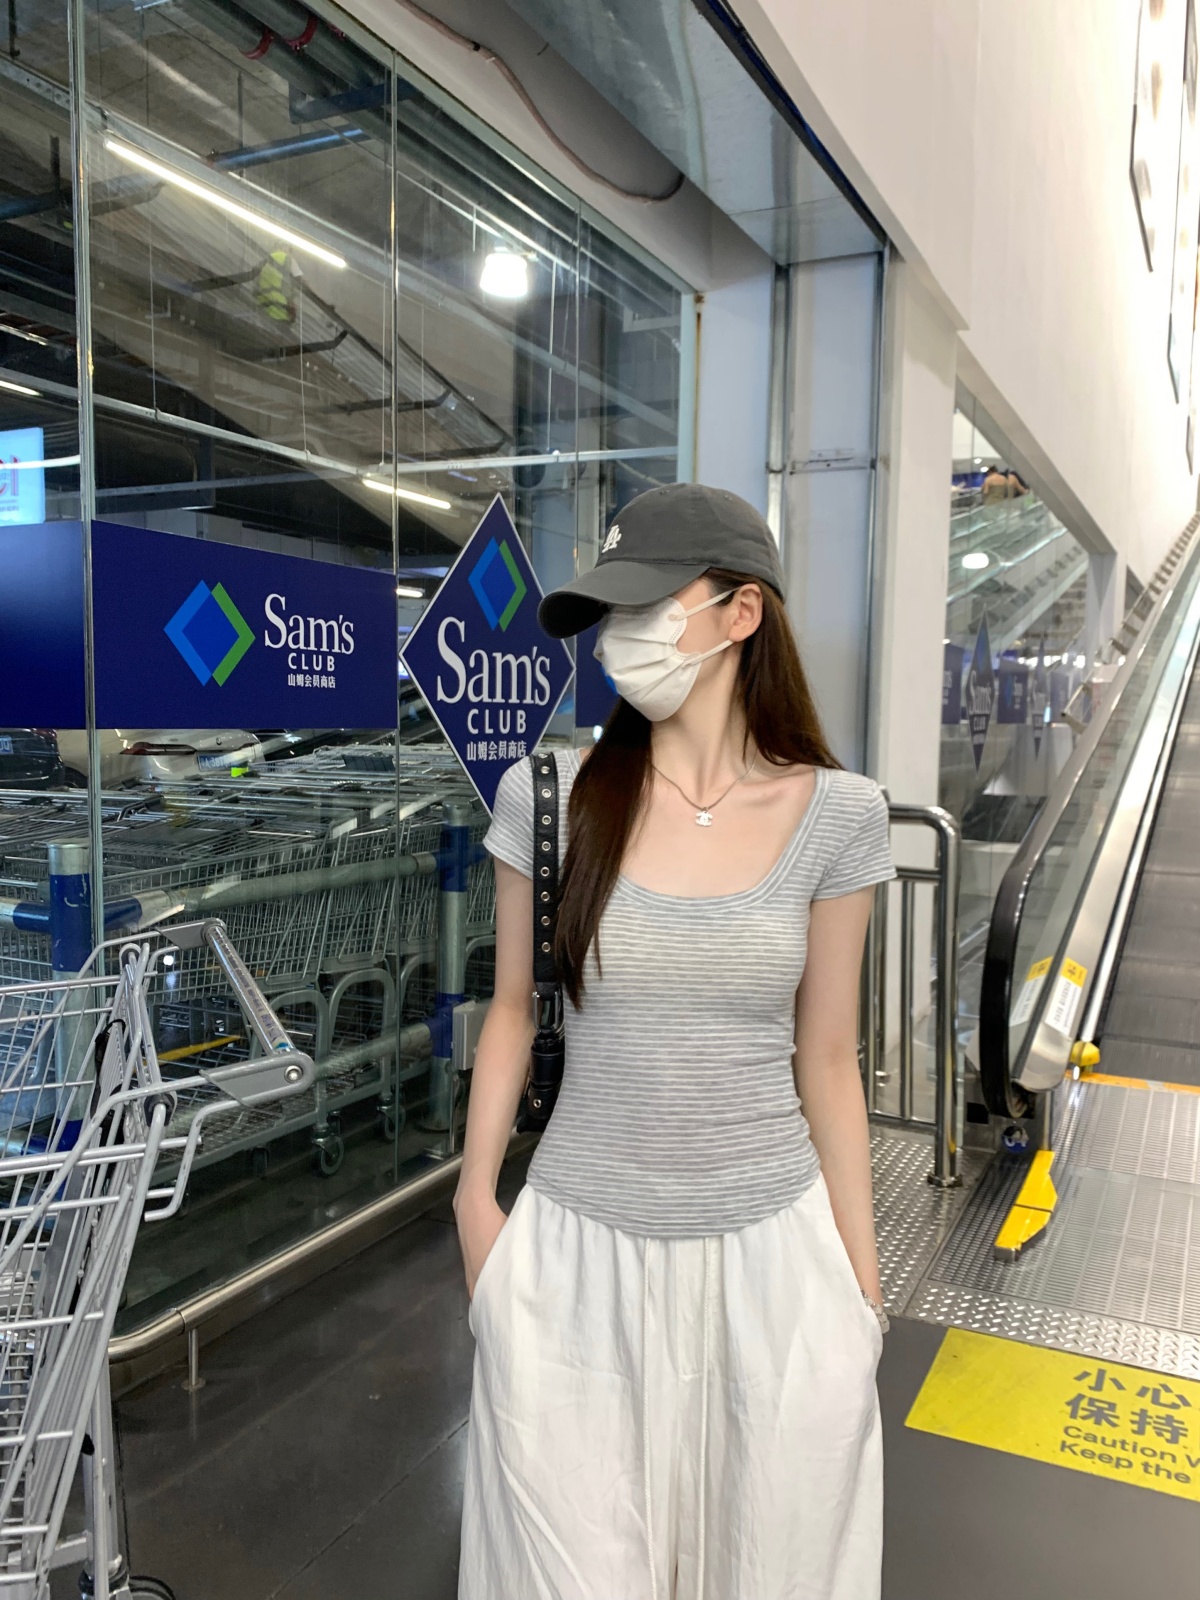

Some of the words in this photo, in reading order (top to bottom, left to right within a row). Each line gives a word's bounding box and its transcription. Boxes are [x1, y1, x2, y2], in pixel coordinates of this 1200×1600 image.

[264, 593, 355, 655] Sam's
[287, 652, 335, 672] CLUB
[436, 616, 551, 706] Sam's
[287, 673, 336, 689] 山姆会员商店
[467, 708, 527, 734] CLUB
[466, 740, 527, 761] 山姆会员商店
[1063, 1425, 1177, 1464] Caution
[1060, 1440, 1134, 1469] Keep
[1141, 1461, 1191, 1484] the
